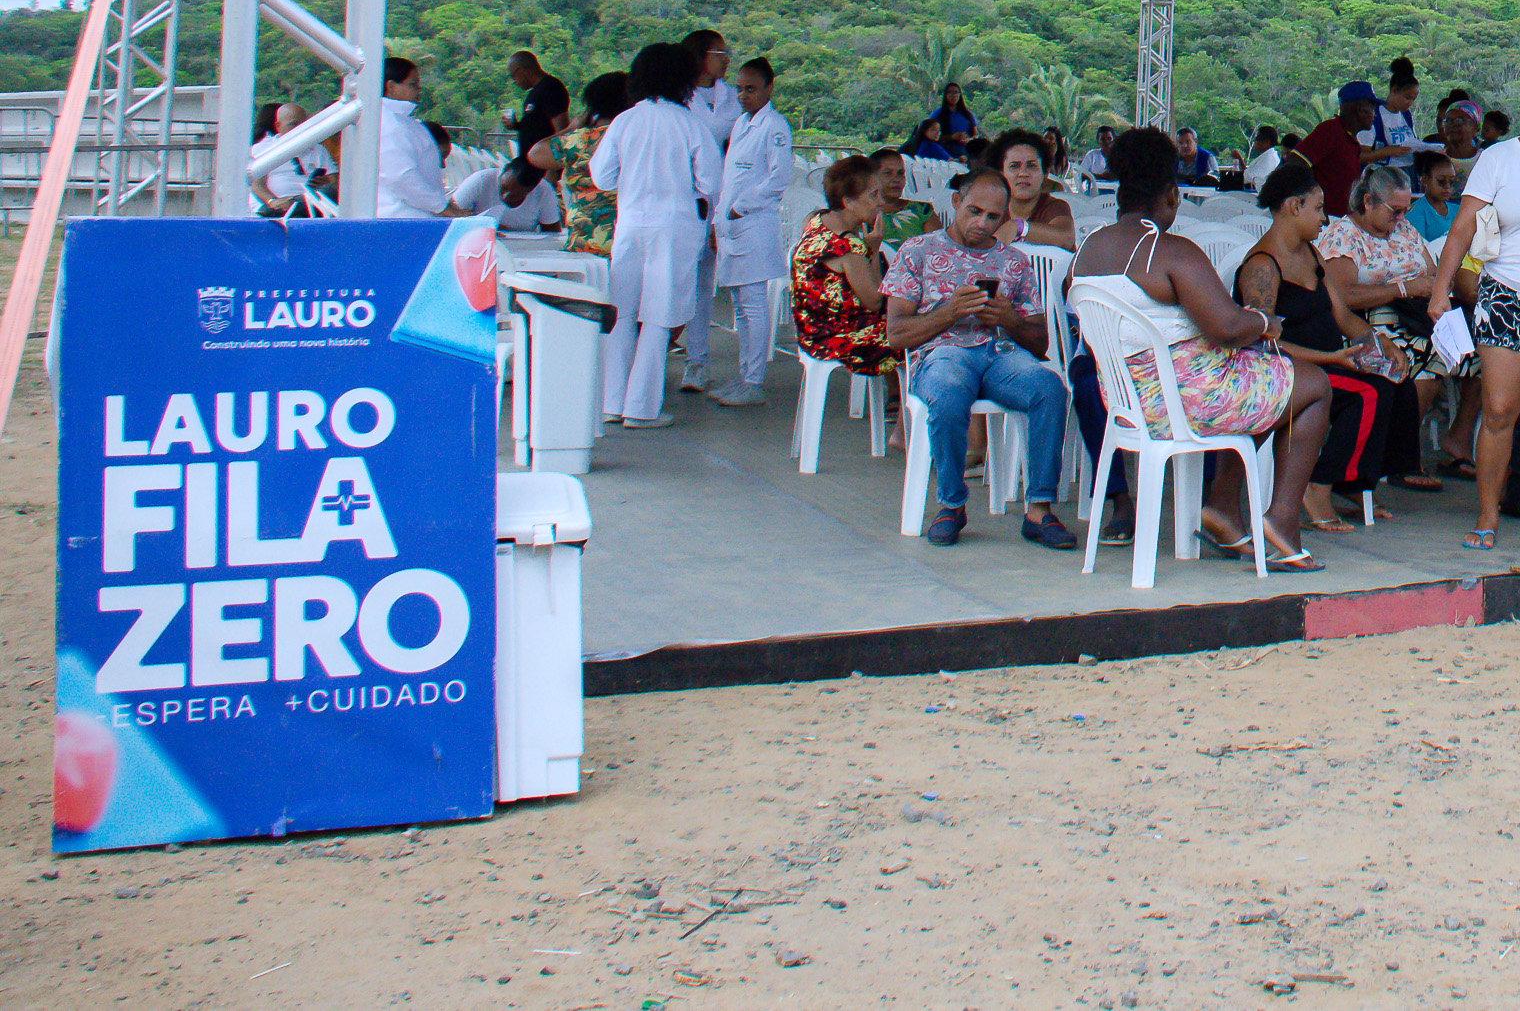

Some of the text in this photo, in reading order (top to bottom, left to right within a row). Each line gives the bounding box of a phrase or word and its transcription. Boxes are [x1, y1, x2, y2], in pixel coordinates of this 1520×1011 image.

[244, 289, 376, 299] PREFEITURA
[244, 300, 377, 330] LAURO
[202, 337, 371, 350] Construindo uma nova história
[104, 387, 396, 456] LAURO
[103, 457, 398, 573] FILA
[96, 568, 471, 694] ZERO
[285, 679, 467, 713] +CUIDADO
